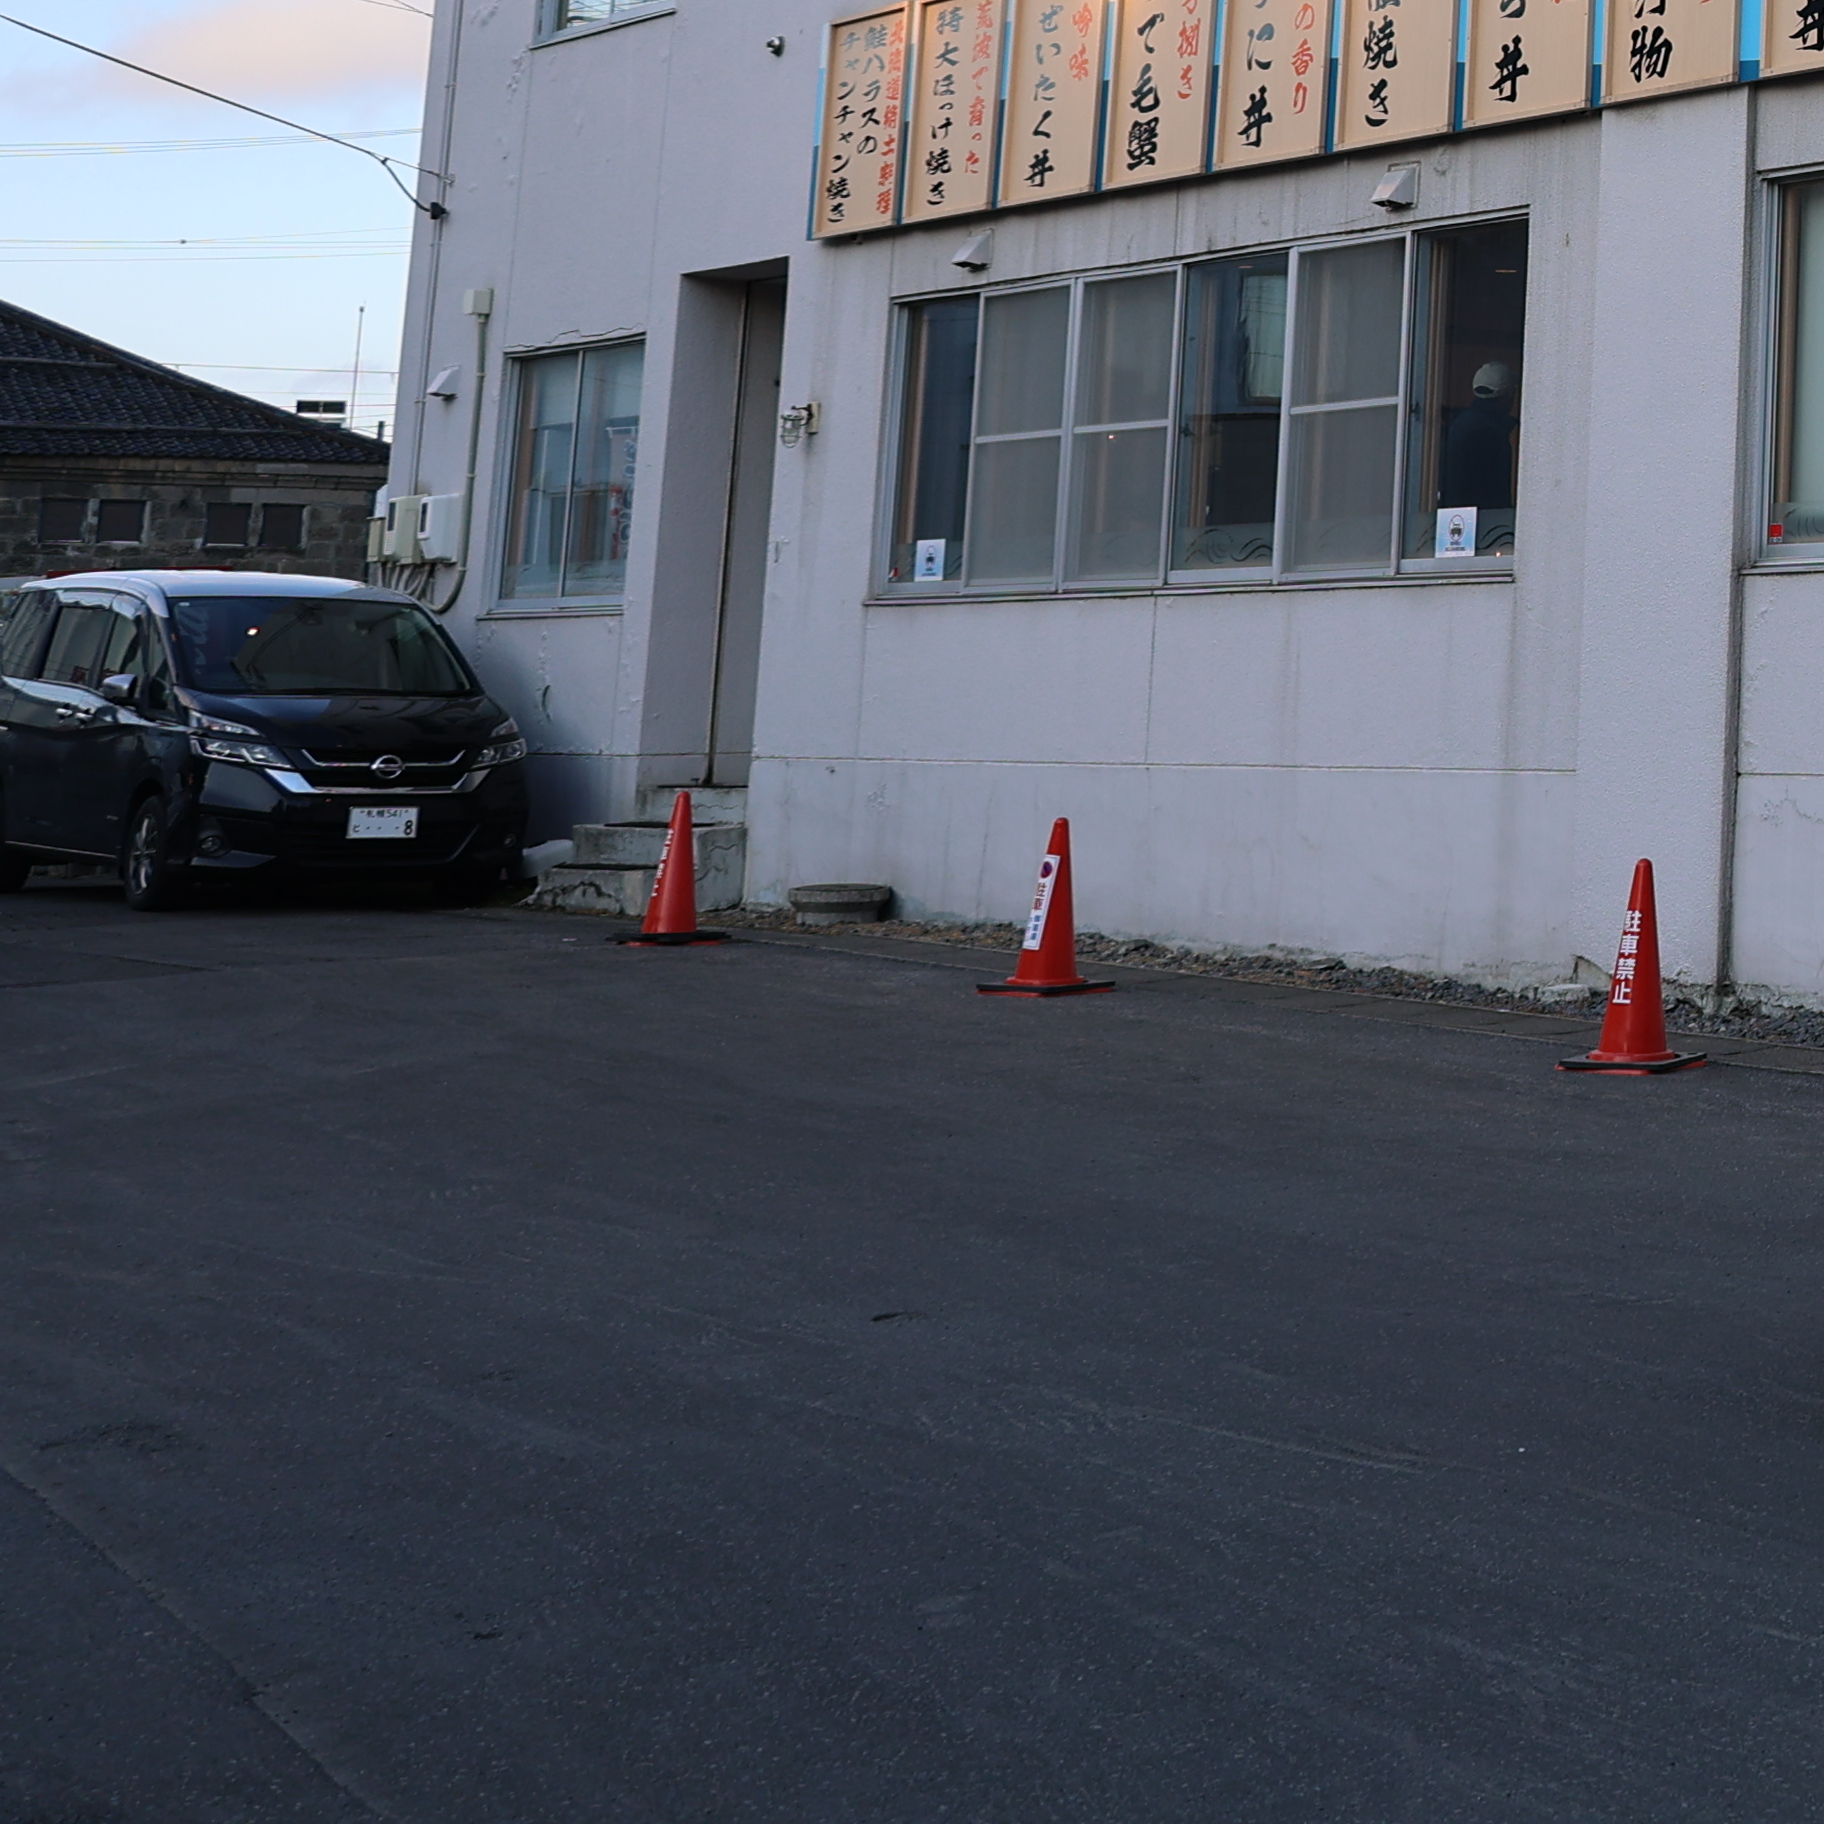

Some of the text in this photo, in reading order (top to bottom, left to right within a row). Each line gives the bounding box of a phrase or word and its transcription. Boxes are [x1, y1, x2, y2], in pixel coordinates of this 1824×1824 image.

[826, 32, 860, 223] チャンチャン焼き
[857, 25, 888, 154] 鮭ハラスの
[926, 6, 964, 205] 特大ほっけ焼き
[1612, 910, 1642, 1004] 駐車禁止
